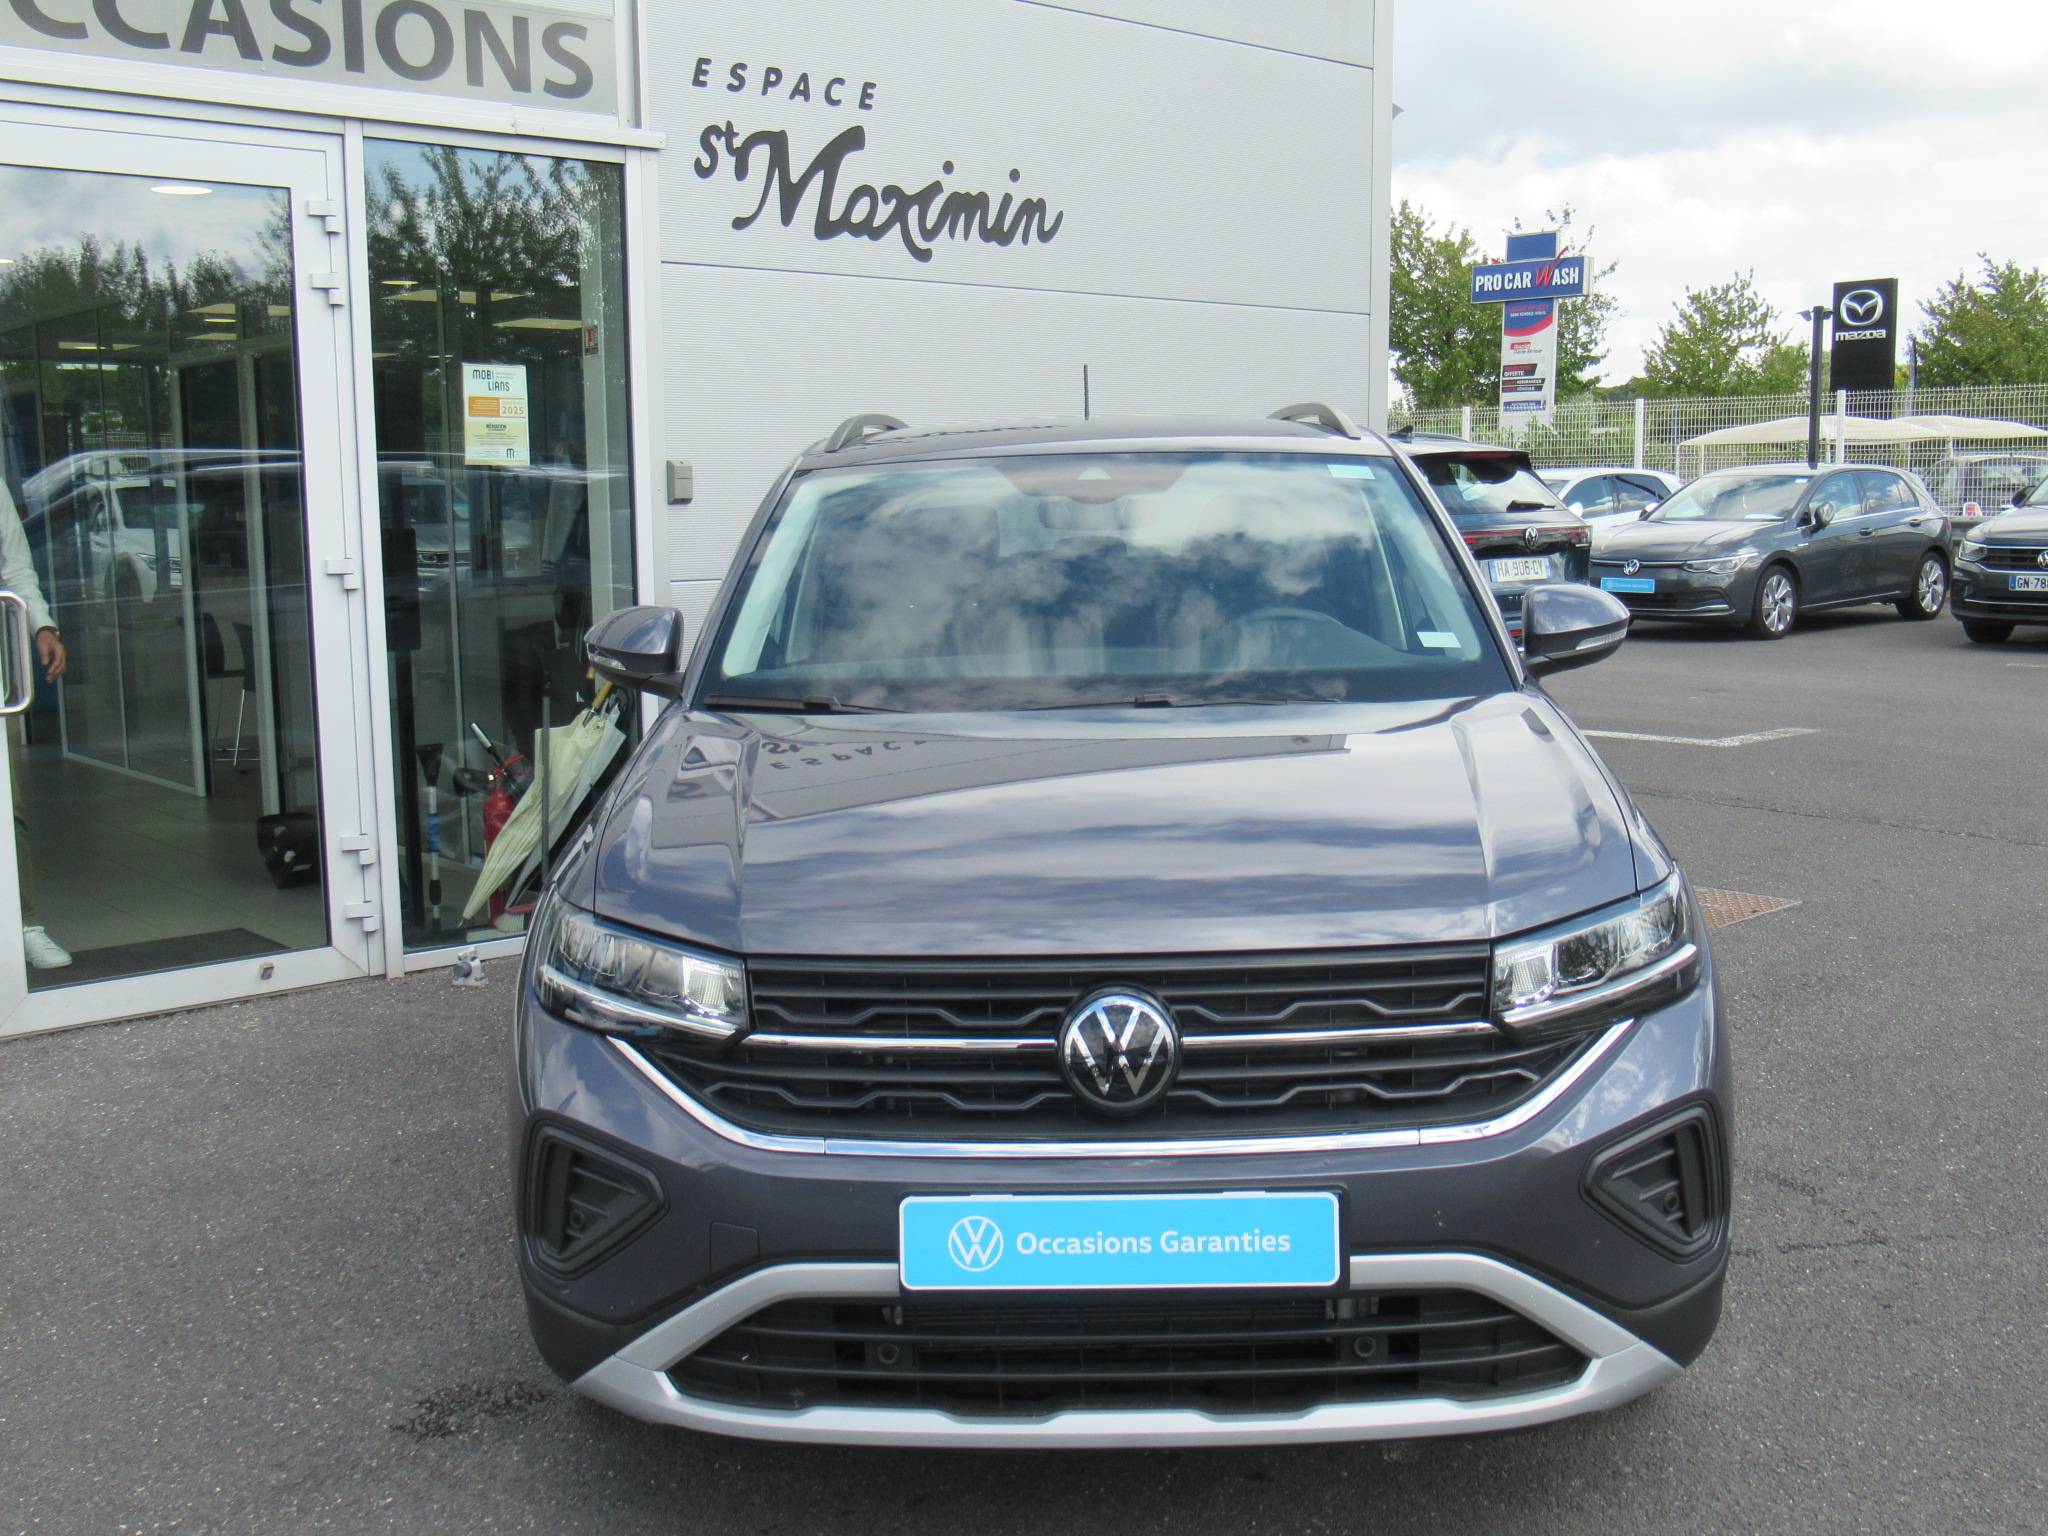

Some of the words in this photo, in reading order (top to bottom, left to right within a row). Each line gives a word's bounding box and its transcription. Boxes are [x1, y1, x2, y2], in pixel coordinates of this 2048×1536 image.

[692, 58, 876, 110] ESPACE
[694, 120, 740, 179] St
[732, 125, 1063, 262] Maximin
[1475, 274, 1502, 292] PRO
[1504, 271, 1532, 290] CAR
[1536, 252, 1579, 288] WASH
[1835, 329, 1886, 341] mazda
[502, 406, 524, 415] 2025
[2017, 577, 2048, 589] GN-78
[1017, 1231, 1152, 1255] Occasions
[1160, 1231, 1291, 1254] Garanties
